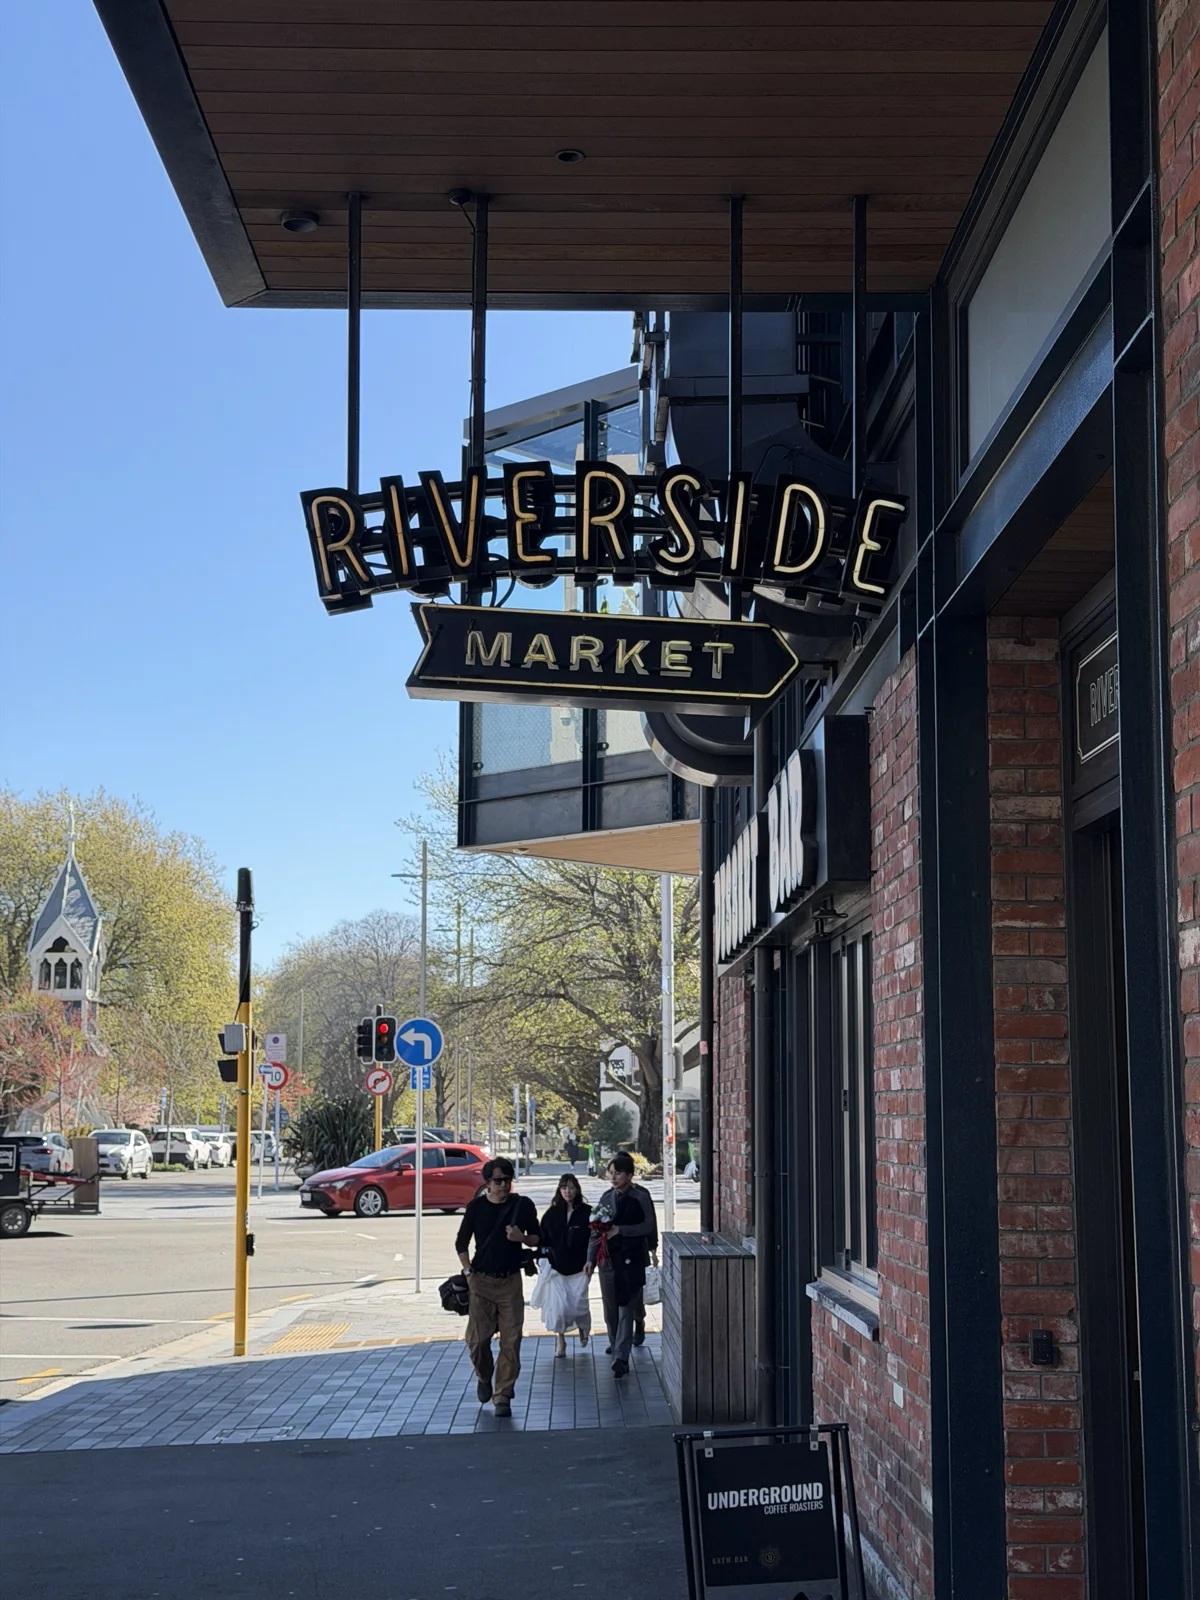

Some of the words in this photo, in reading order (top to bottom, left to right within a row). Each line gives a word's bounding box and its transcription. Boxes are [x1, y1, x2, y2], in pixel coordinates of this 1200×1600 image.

[301, 461, 908, 611] RIVERSIDE
[465, 630, 734, 679] MARKET
[768, 749, 803, 913] BAR
[707, 1482, 823, 1509] UNDERGROUND
[764, 1504, 788, 1515] COFFEE
[789, 1500, 824, 1512] ROASTERS
